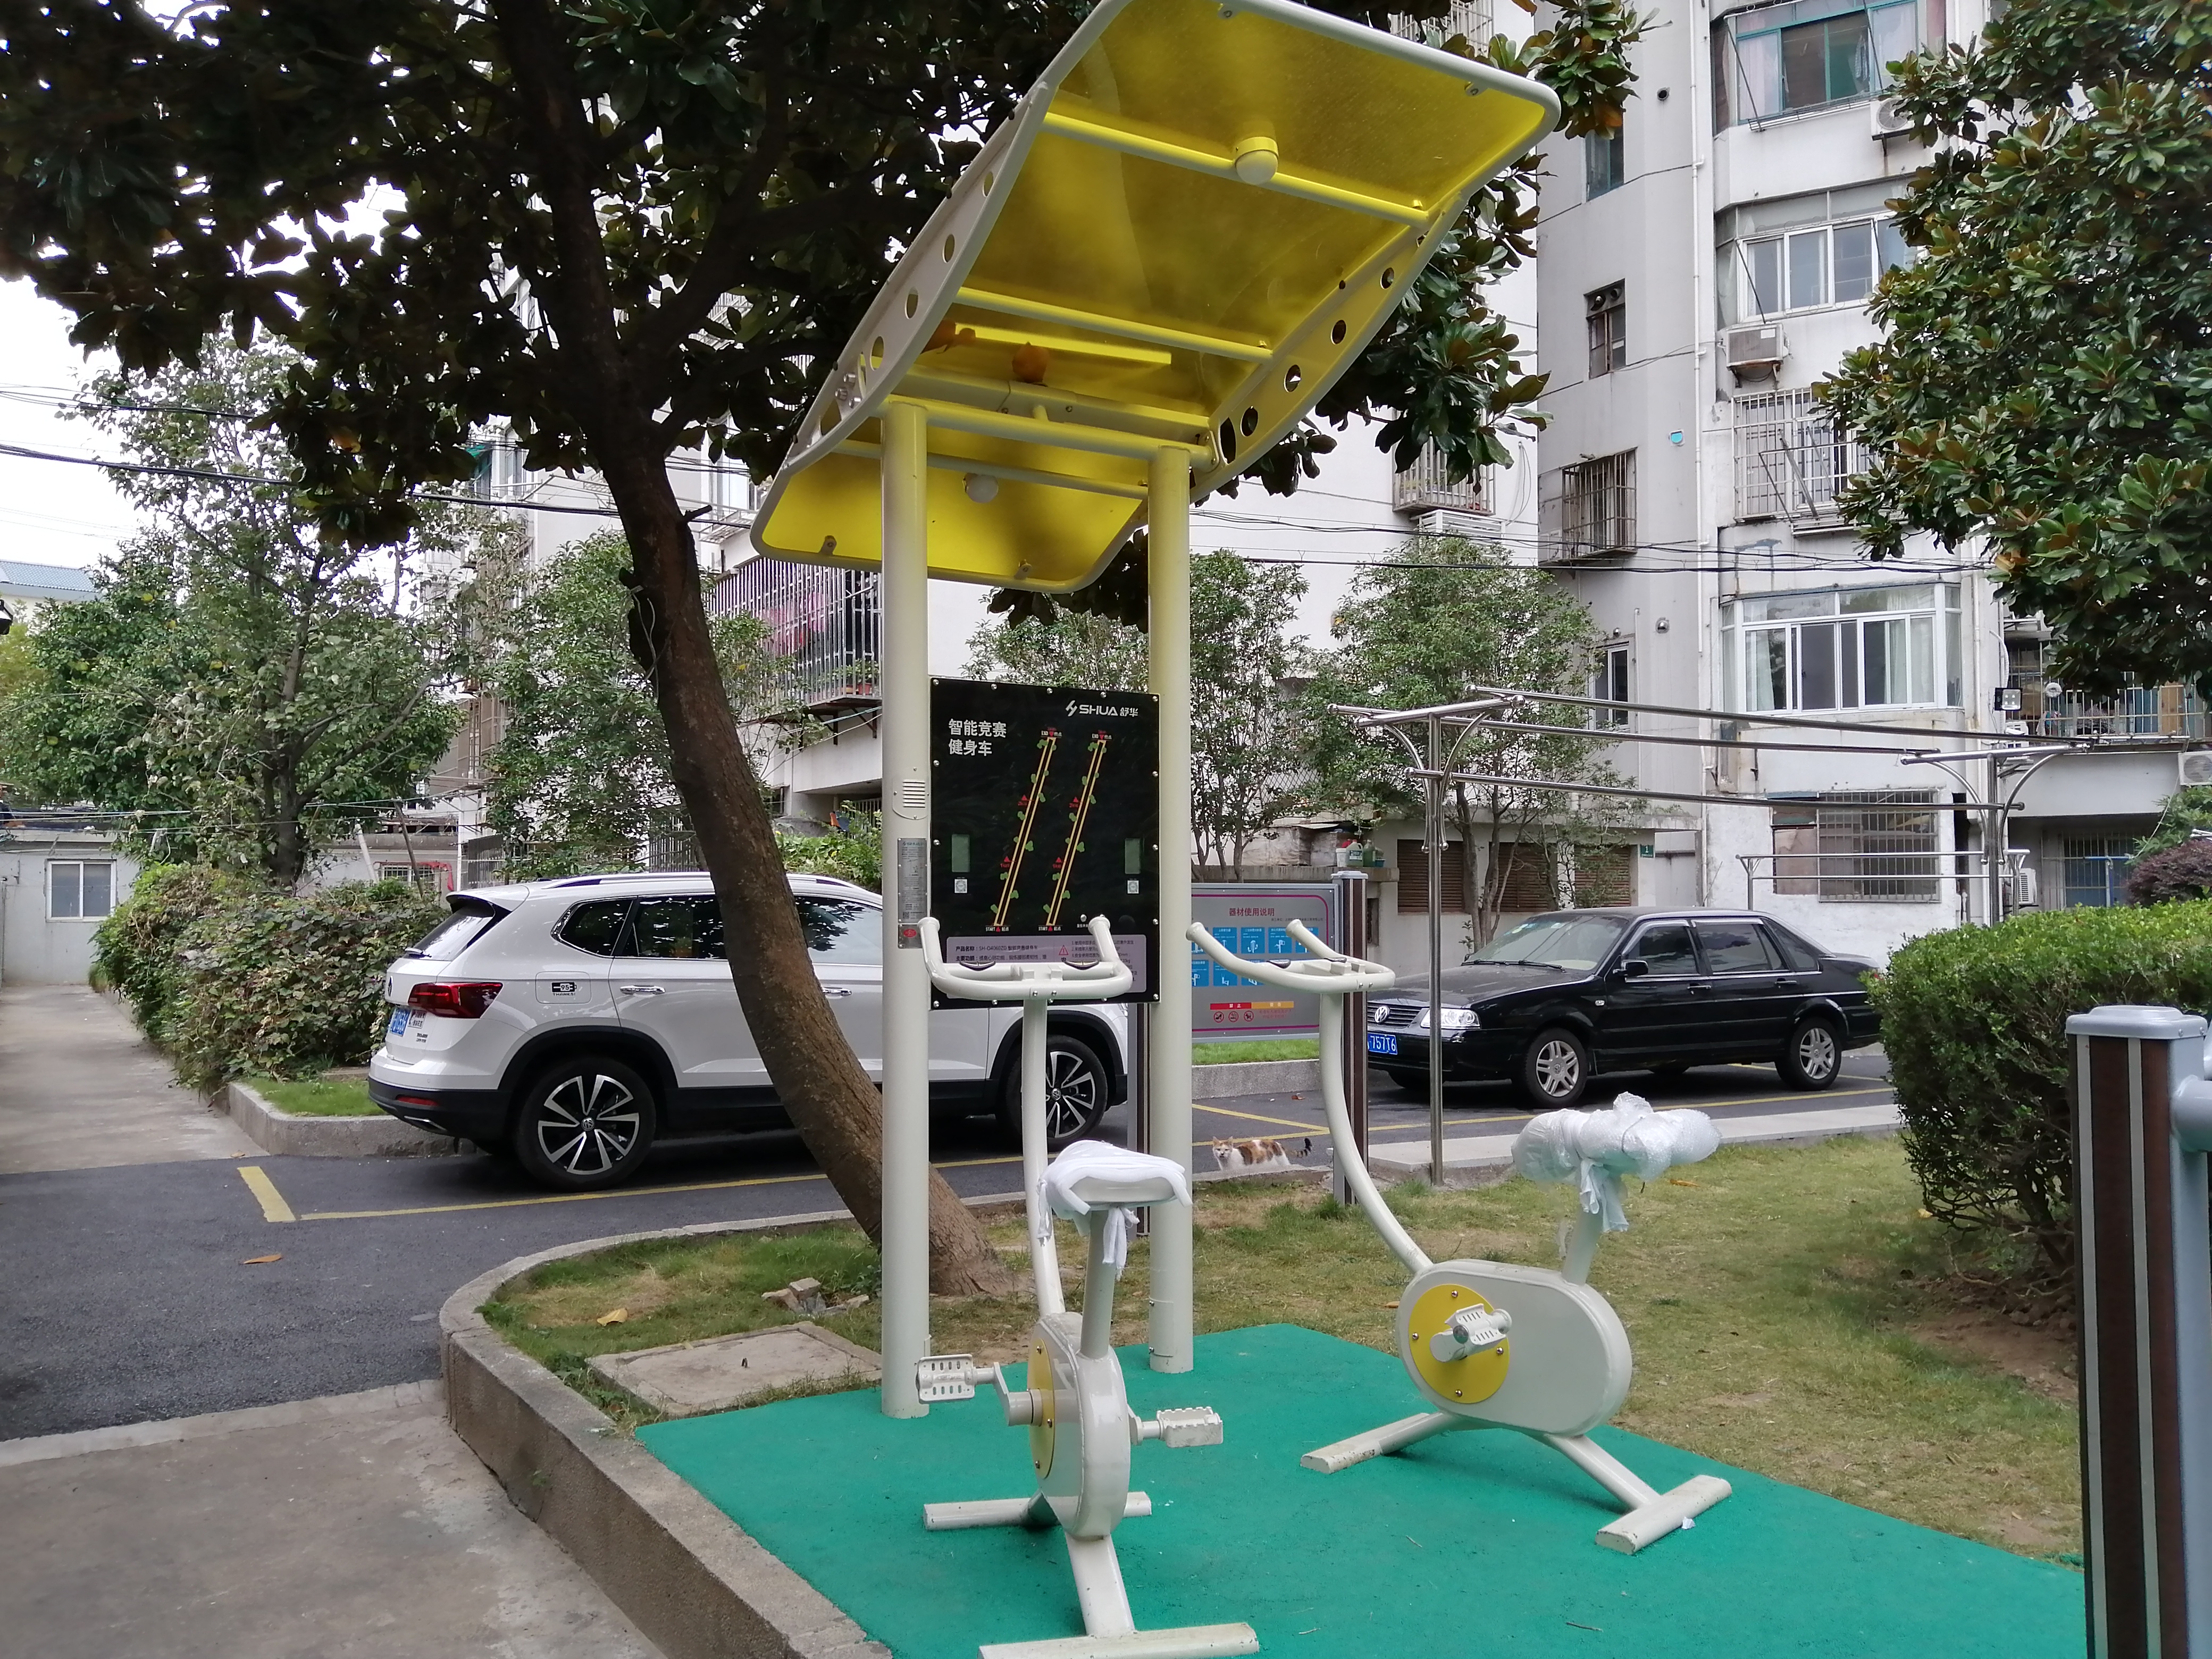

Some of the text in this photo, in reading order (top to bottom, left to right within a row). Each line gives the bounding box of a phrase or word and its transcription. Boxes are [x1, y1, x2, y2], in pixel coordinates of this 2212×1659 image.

[1079, 705, 1138, 717] SHUA 舒华
[949, 718, 1007, 738] 智能竞赛
[949, 739, 992, 756] 健身车
[1229, 907, 1275, 916] 器材使用说明
